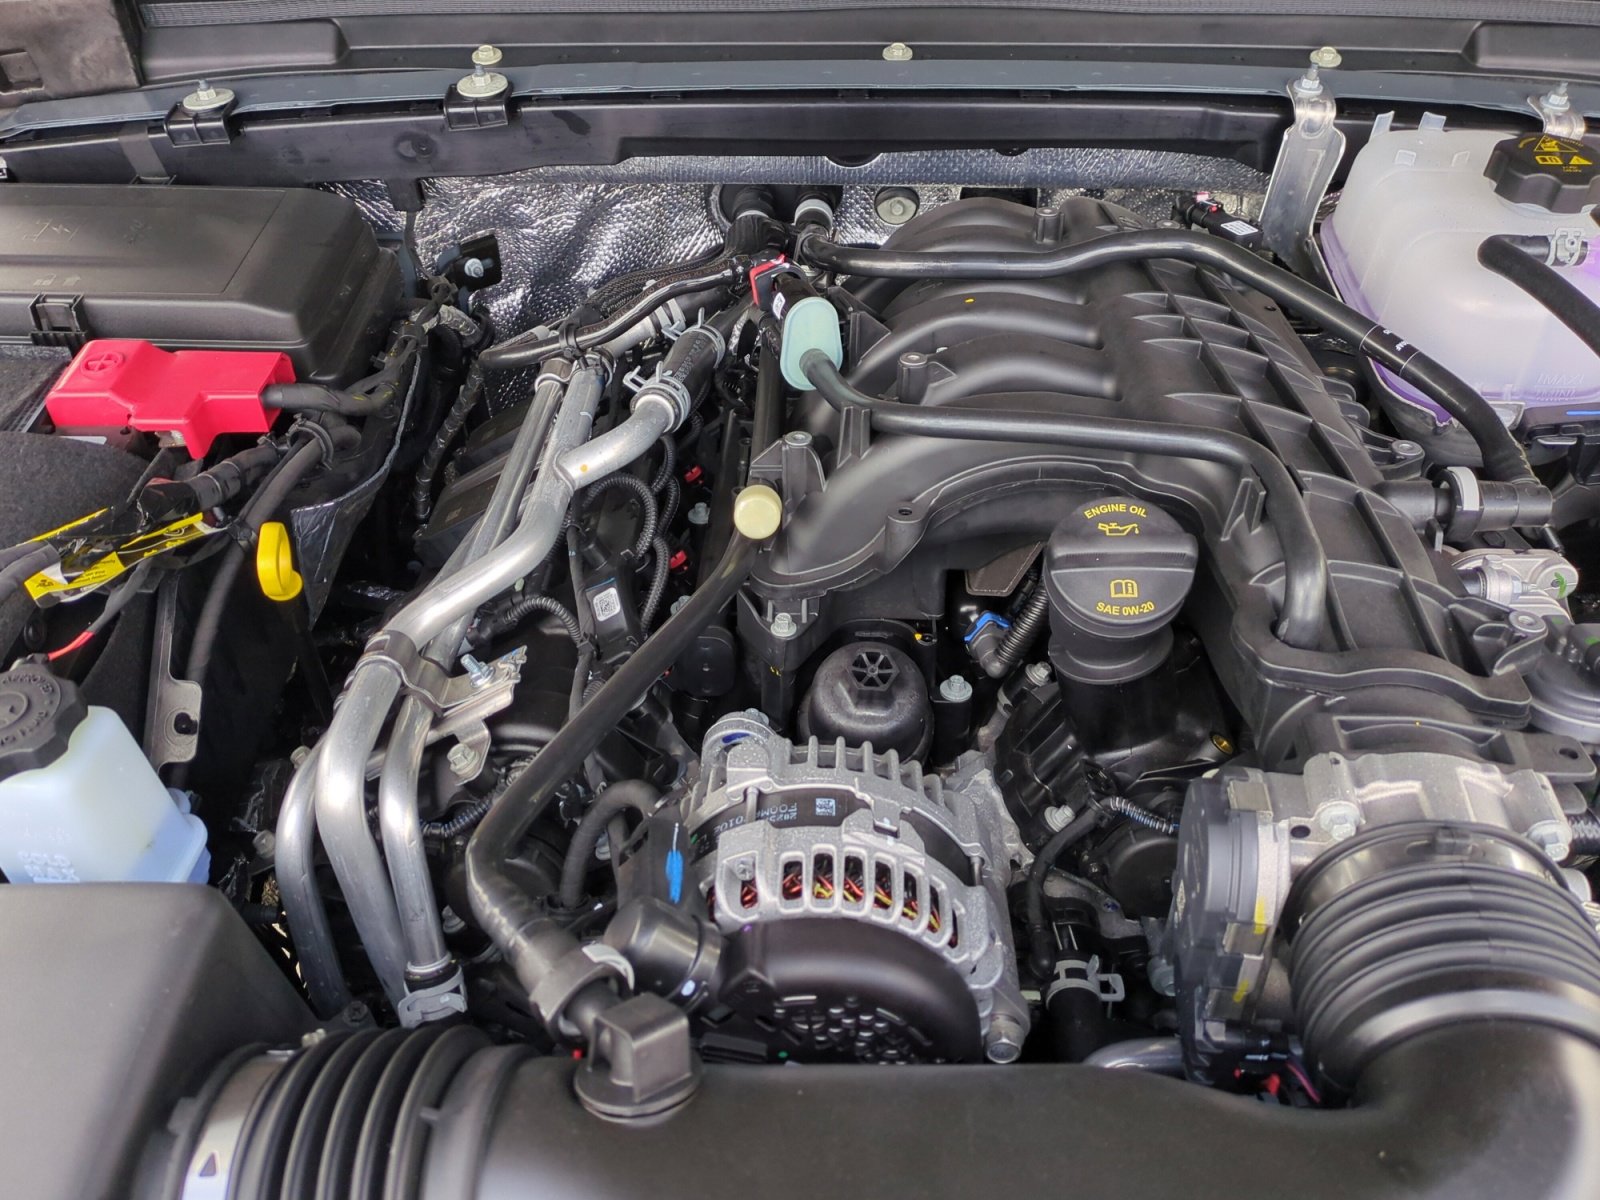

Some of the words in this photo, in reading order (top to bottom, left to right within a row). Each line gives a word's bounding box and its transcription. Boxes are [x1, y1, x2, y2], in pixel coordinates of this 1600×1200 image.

[1083, 503, 1127, 520] ENGINE
[1129, 505, 1148, 518] OIL
[1096, 602, 1120, 616] SAE
[1122, 600, 1155, 616] 0W-20
